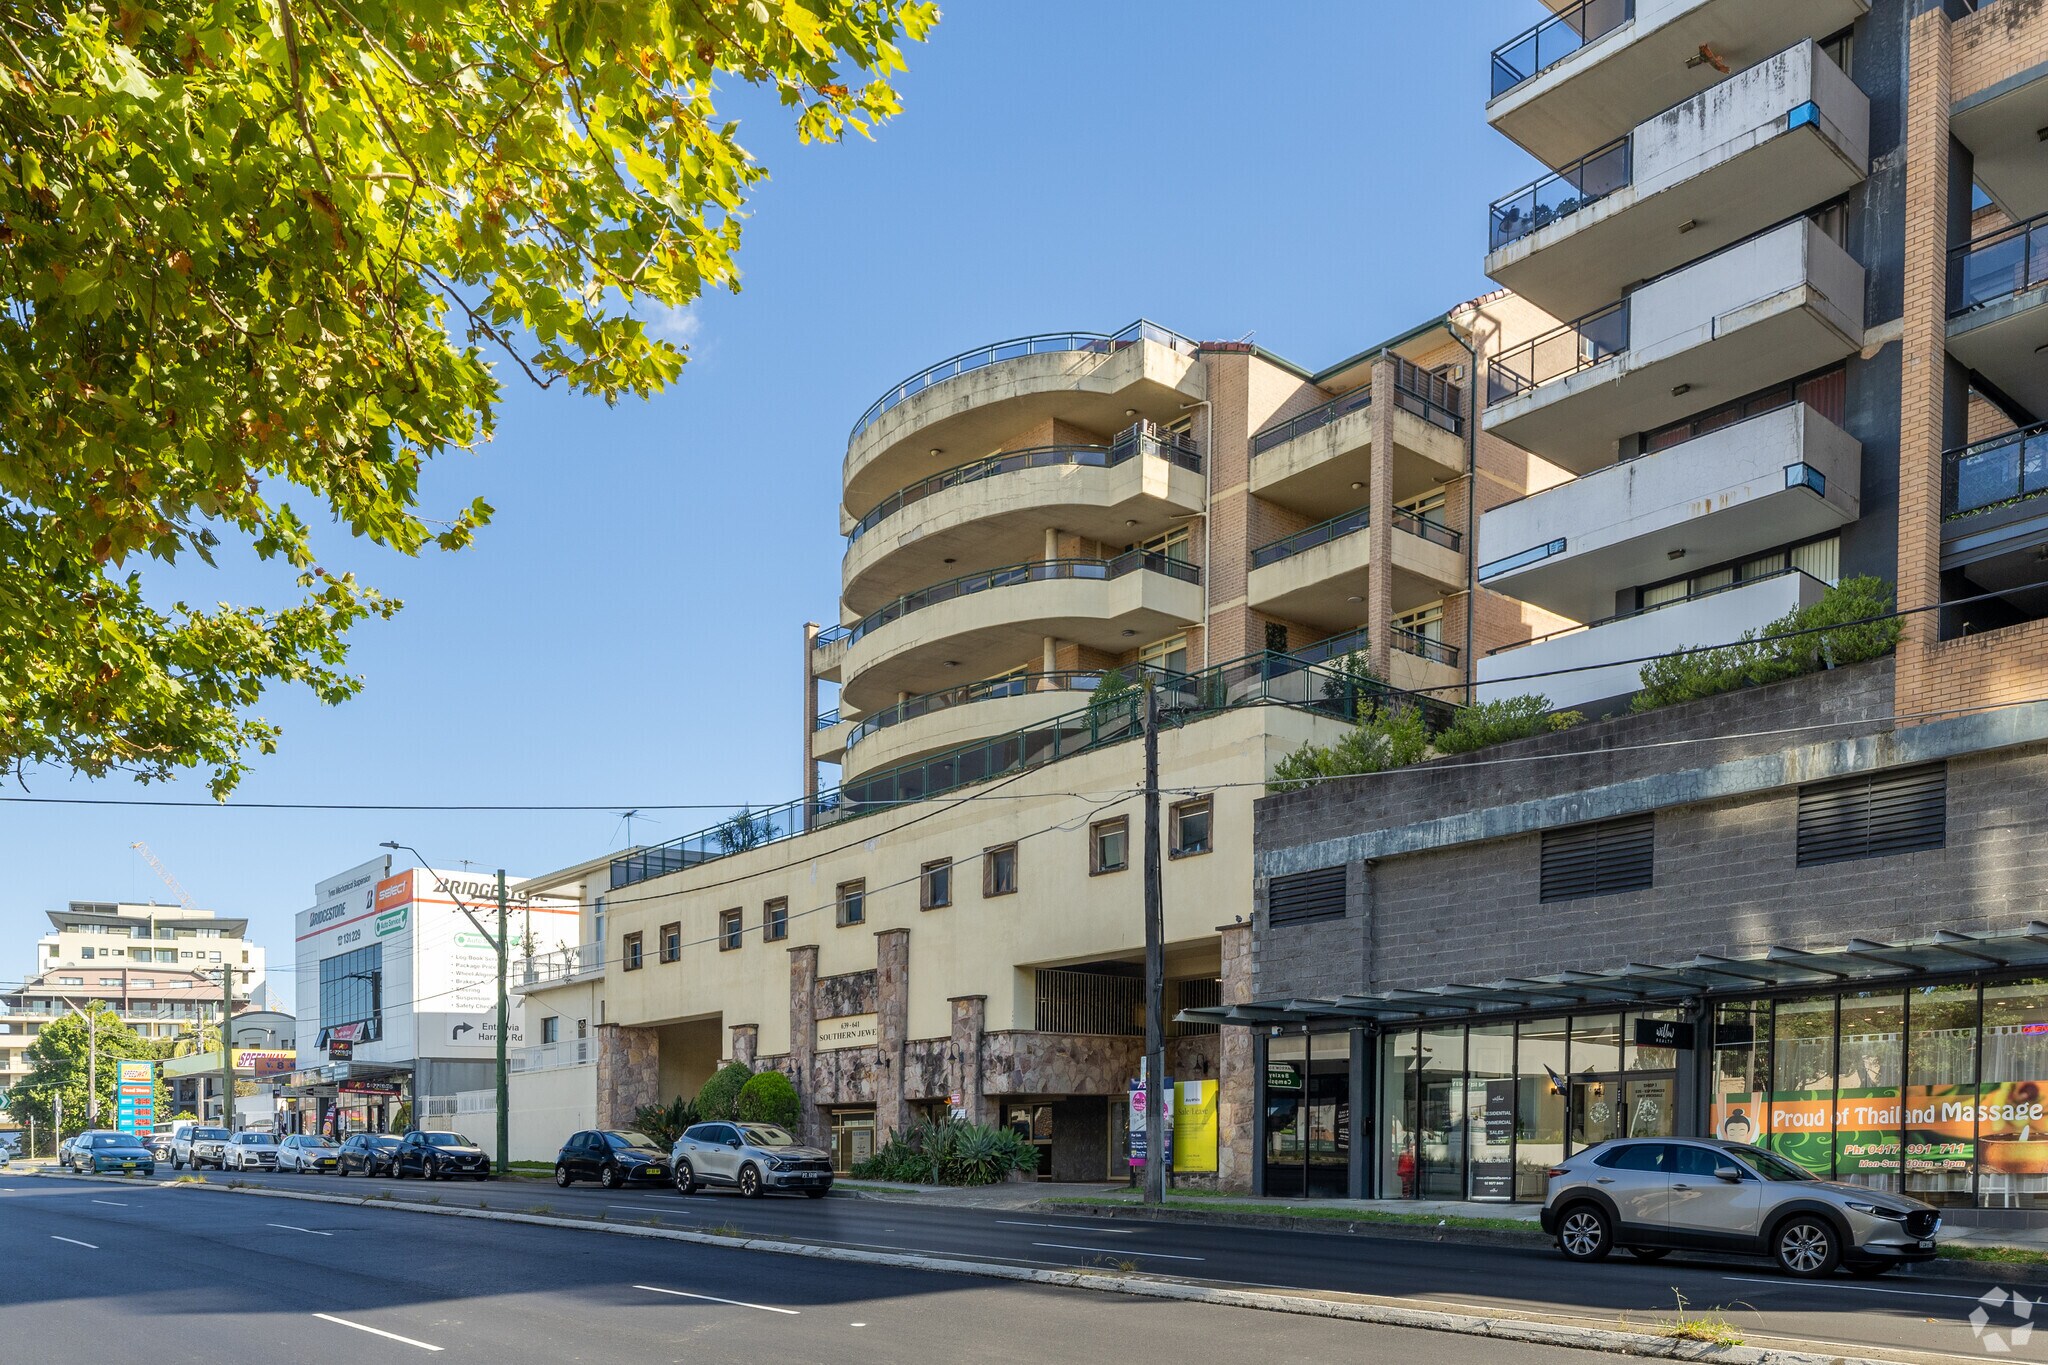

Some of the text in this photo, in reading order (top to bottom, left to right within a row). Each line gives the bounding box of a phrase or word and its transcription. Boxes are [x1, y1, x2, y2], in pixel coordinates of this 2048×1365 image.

[309, 902, 346, 927] BRIDGESTONE
[344, 929, 361, 945] 131 229
[511, 1034, 523, 1042] Rd
[819, 1030, 856, 1041] SOUTHERN
[1773, 1101, 2044, 1127] Proud of Thailand Massage
[1844, 1143, 1965, 1154] Ph: 0417 991 711
[1858, 1159, 1900, 1168] Mon-Sun
[1906, 1160, 1933, 1168] 10am
[1942, 1160, 1966, 1168] 9pm
